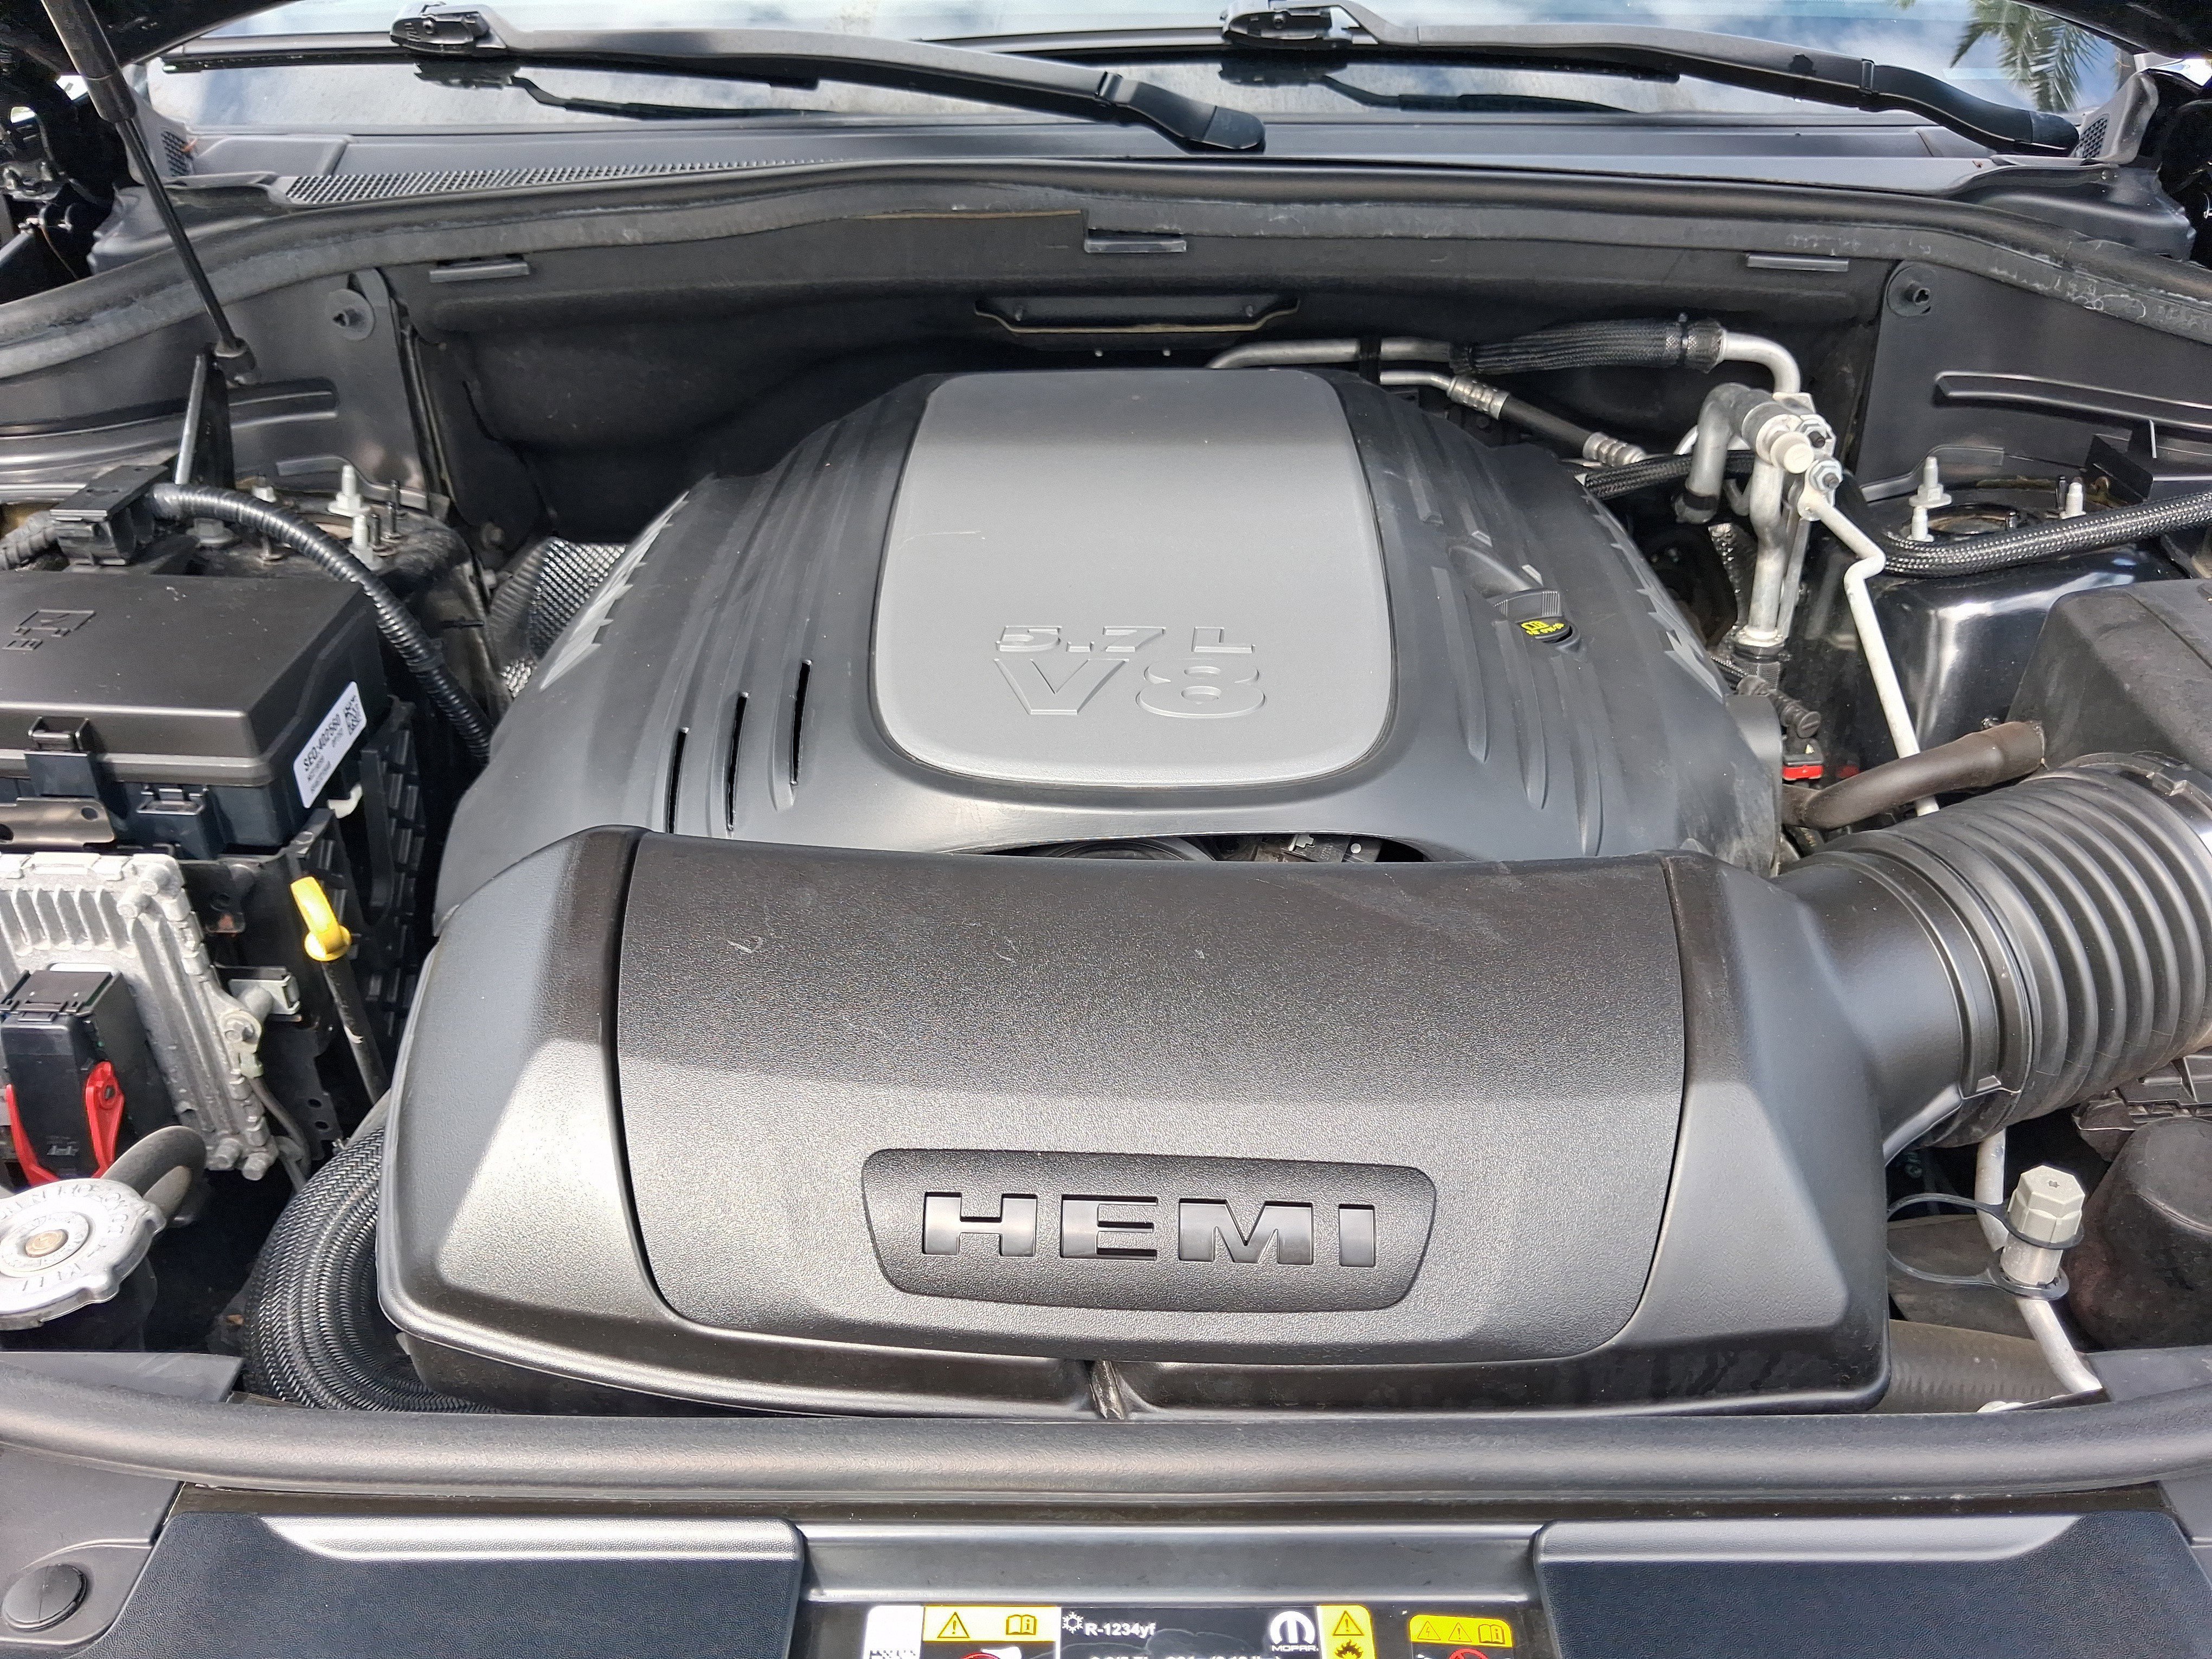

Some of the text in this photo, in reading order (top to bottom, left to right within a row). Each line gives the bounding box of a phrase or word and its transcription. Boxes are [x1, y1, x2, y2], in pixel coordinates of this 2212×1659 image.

[993, 658, 1266, 719] V8
[922, 1191, 1377, 1267] HEMI
[1085, 1622, 1156, 1639] R-1234yf
